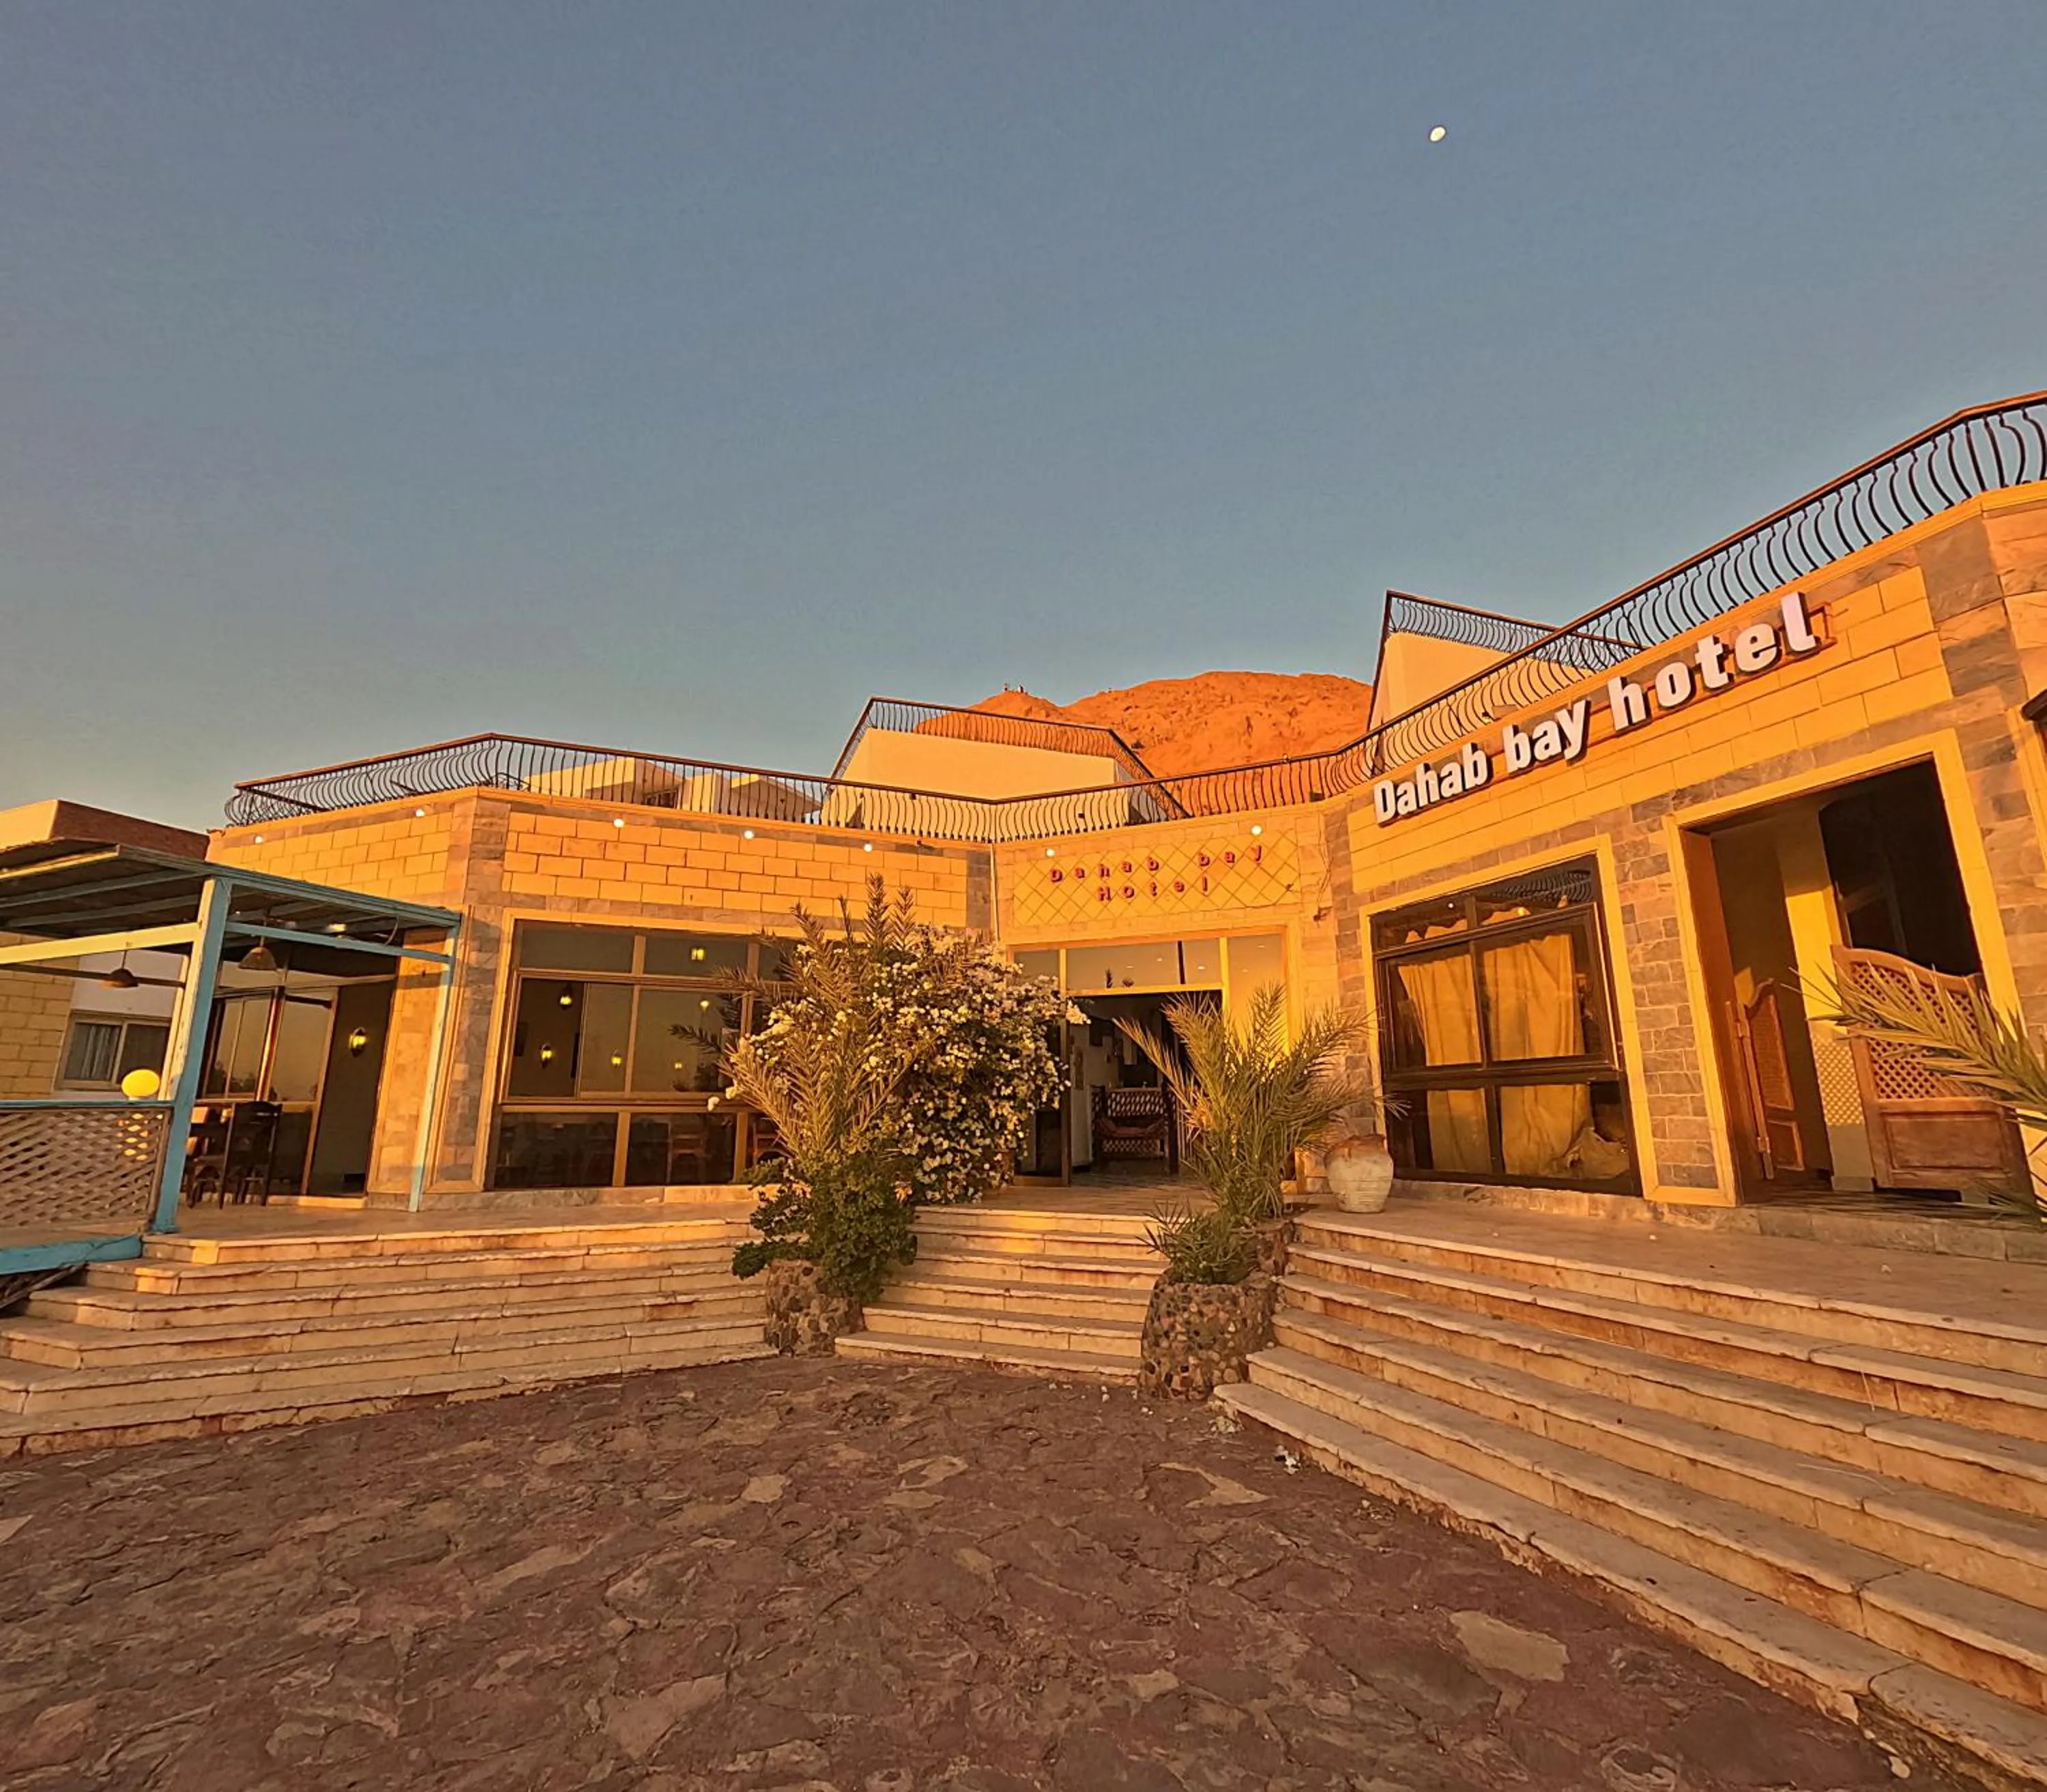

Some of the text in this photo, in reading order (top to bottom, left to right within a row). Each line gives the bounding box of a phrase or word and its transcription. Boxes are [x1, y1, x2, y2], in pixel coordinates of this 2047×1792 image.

[1373, 591, 1816, 824] Dahab bay hotel
[1049, 844, 1262, 884] Dahab bay
[1098, 876, 1208, 901] Hotel
